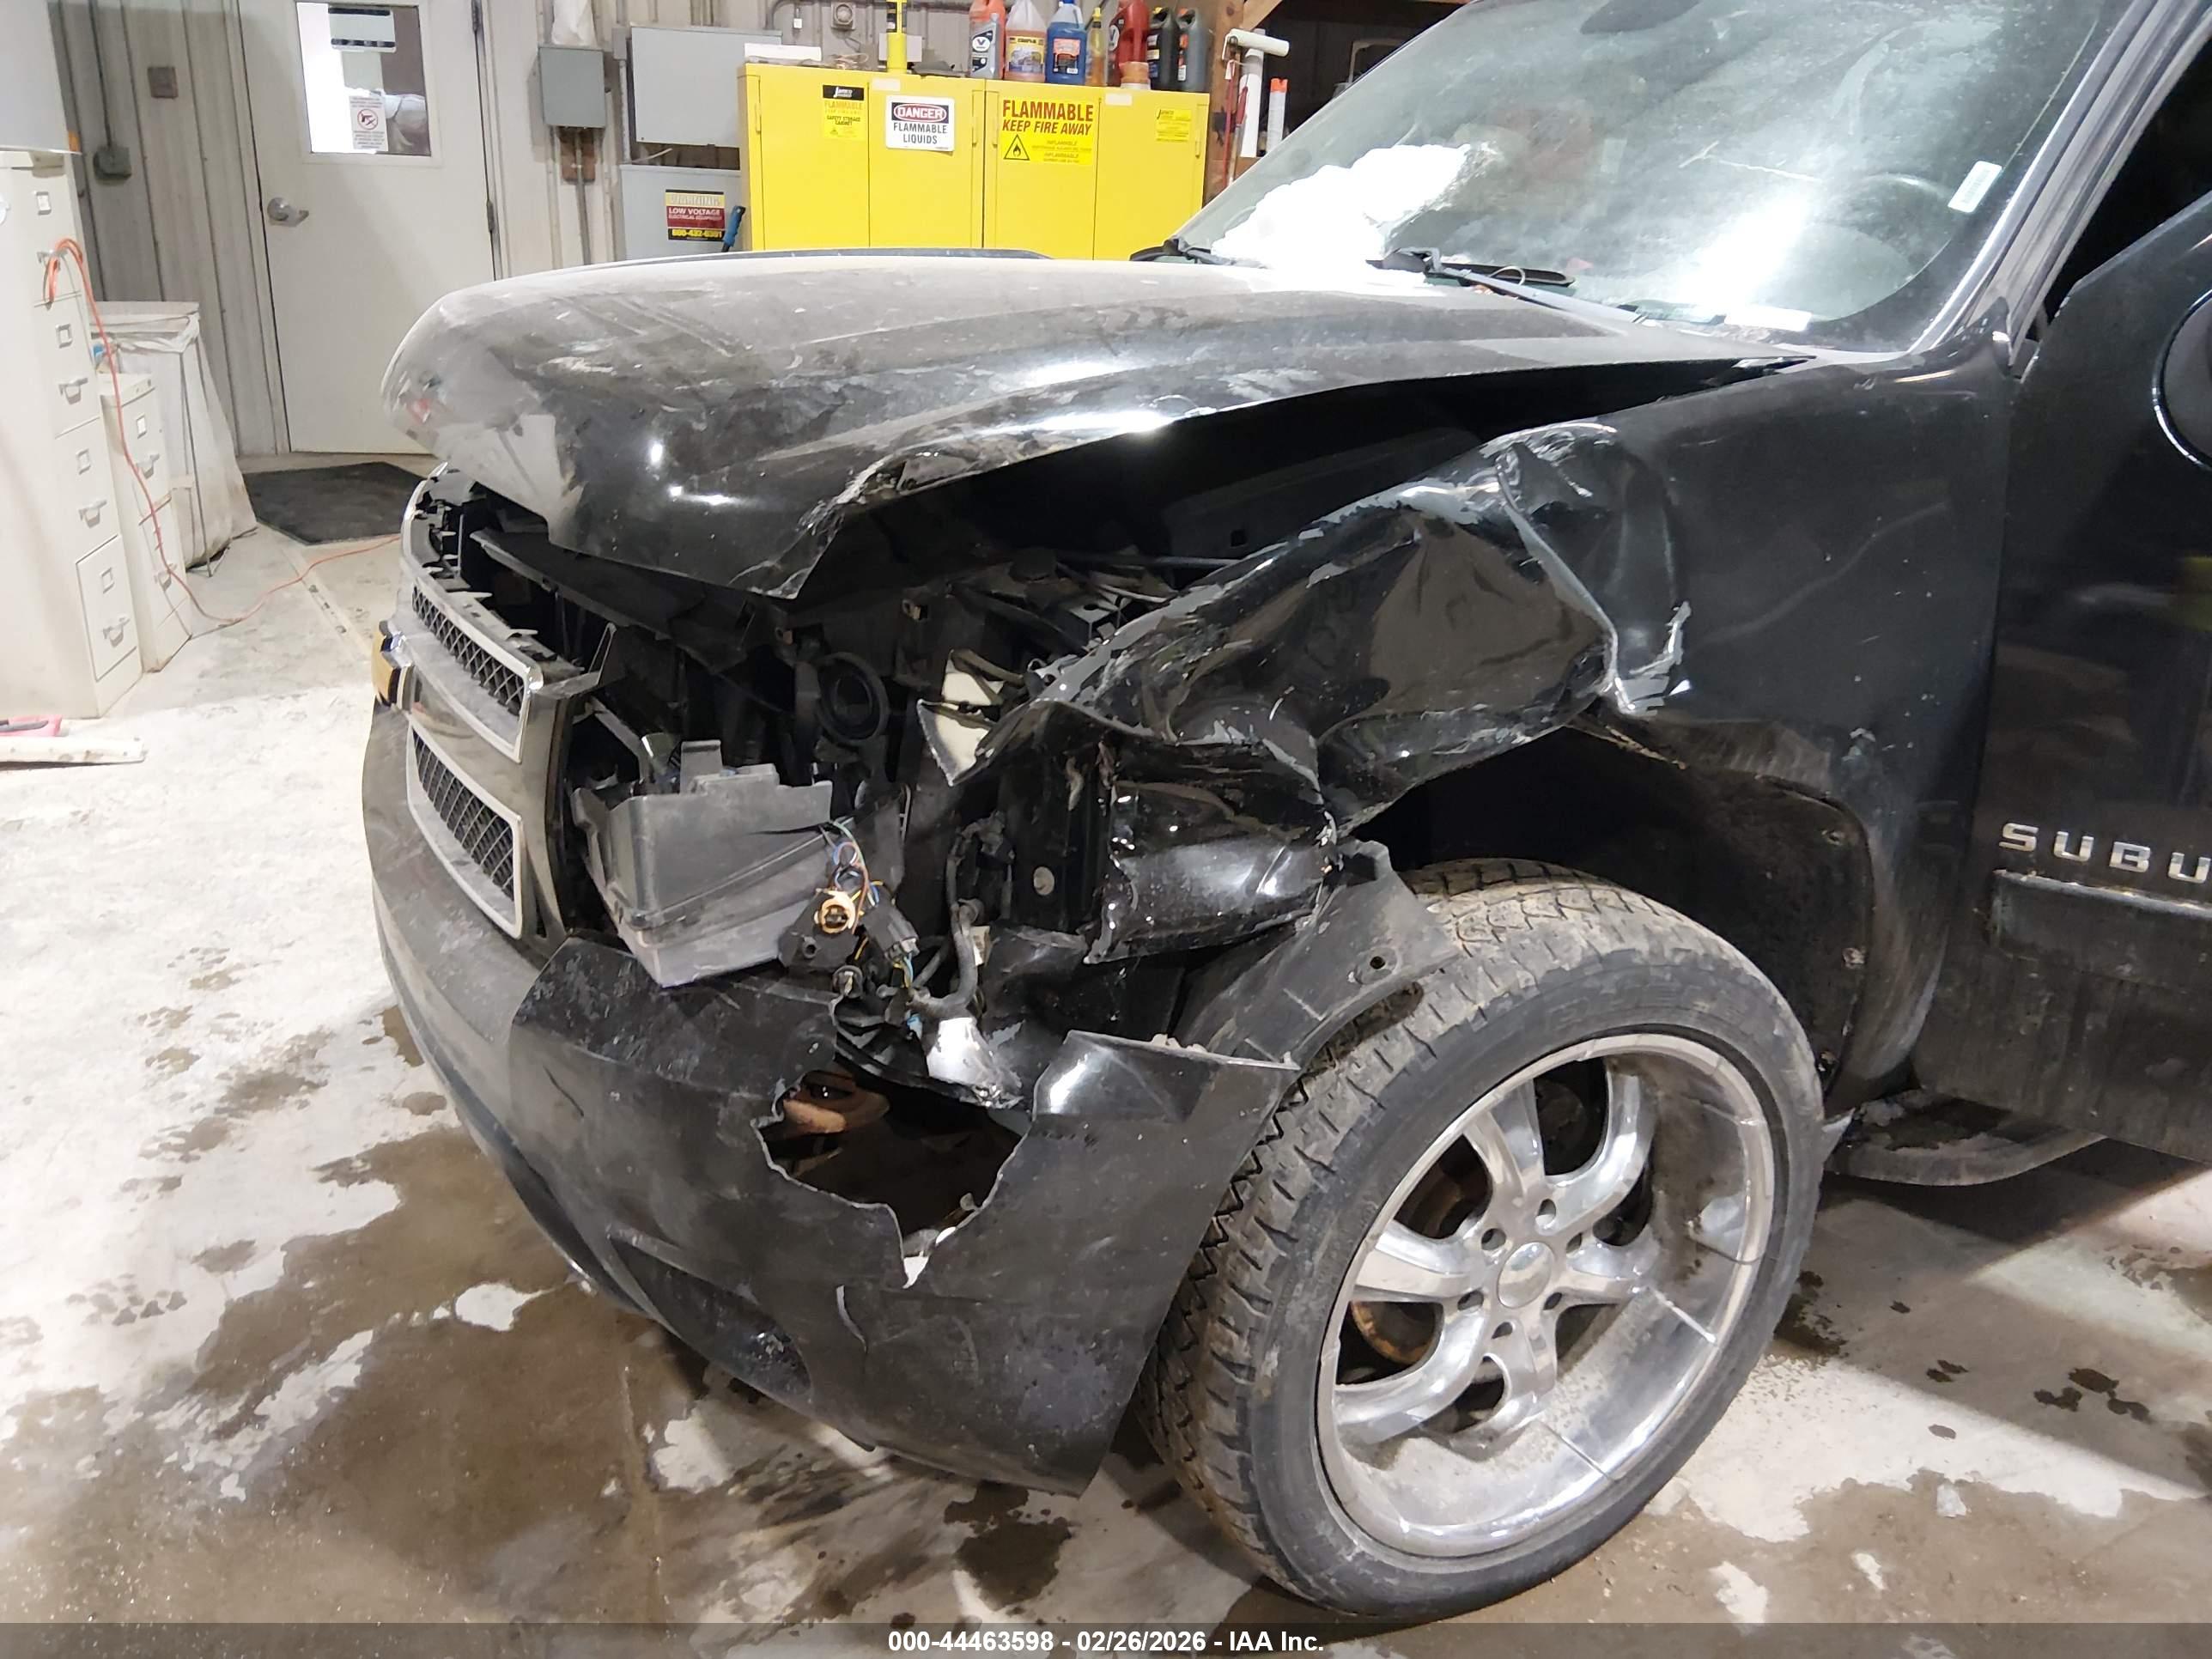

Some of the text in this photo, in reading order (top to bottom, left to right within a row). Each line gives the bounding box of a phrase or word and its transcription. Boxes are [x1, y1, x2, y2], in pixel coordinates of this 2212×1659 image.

[897, 106, 944, 119] DANGER
[1002, 100, 1094, 122] FLAMMABLE
[893, 122, 947, 134] FLAMMABLE
[1002, 119, 1092, 136] KEEP FIRE AWAY
[902, 134, 938, 144] LIQUIDS
[1999, 822, 2212, 884] SUBU
